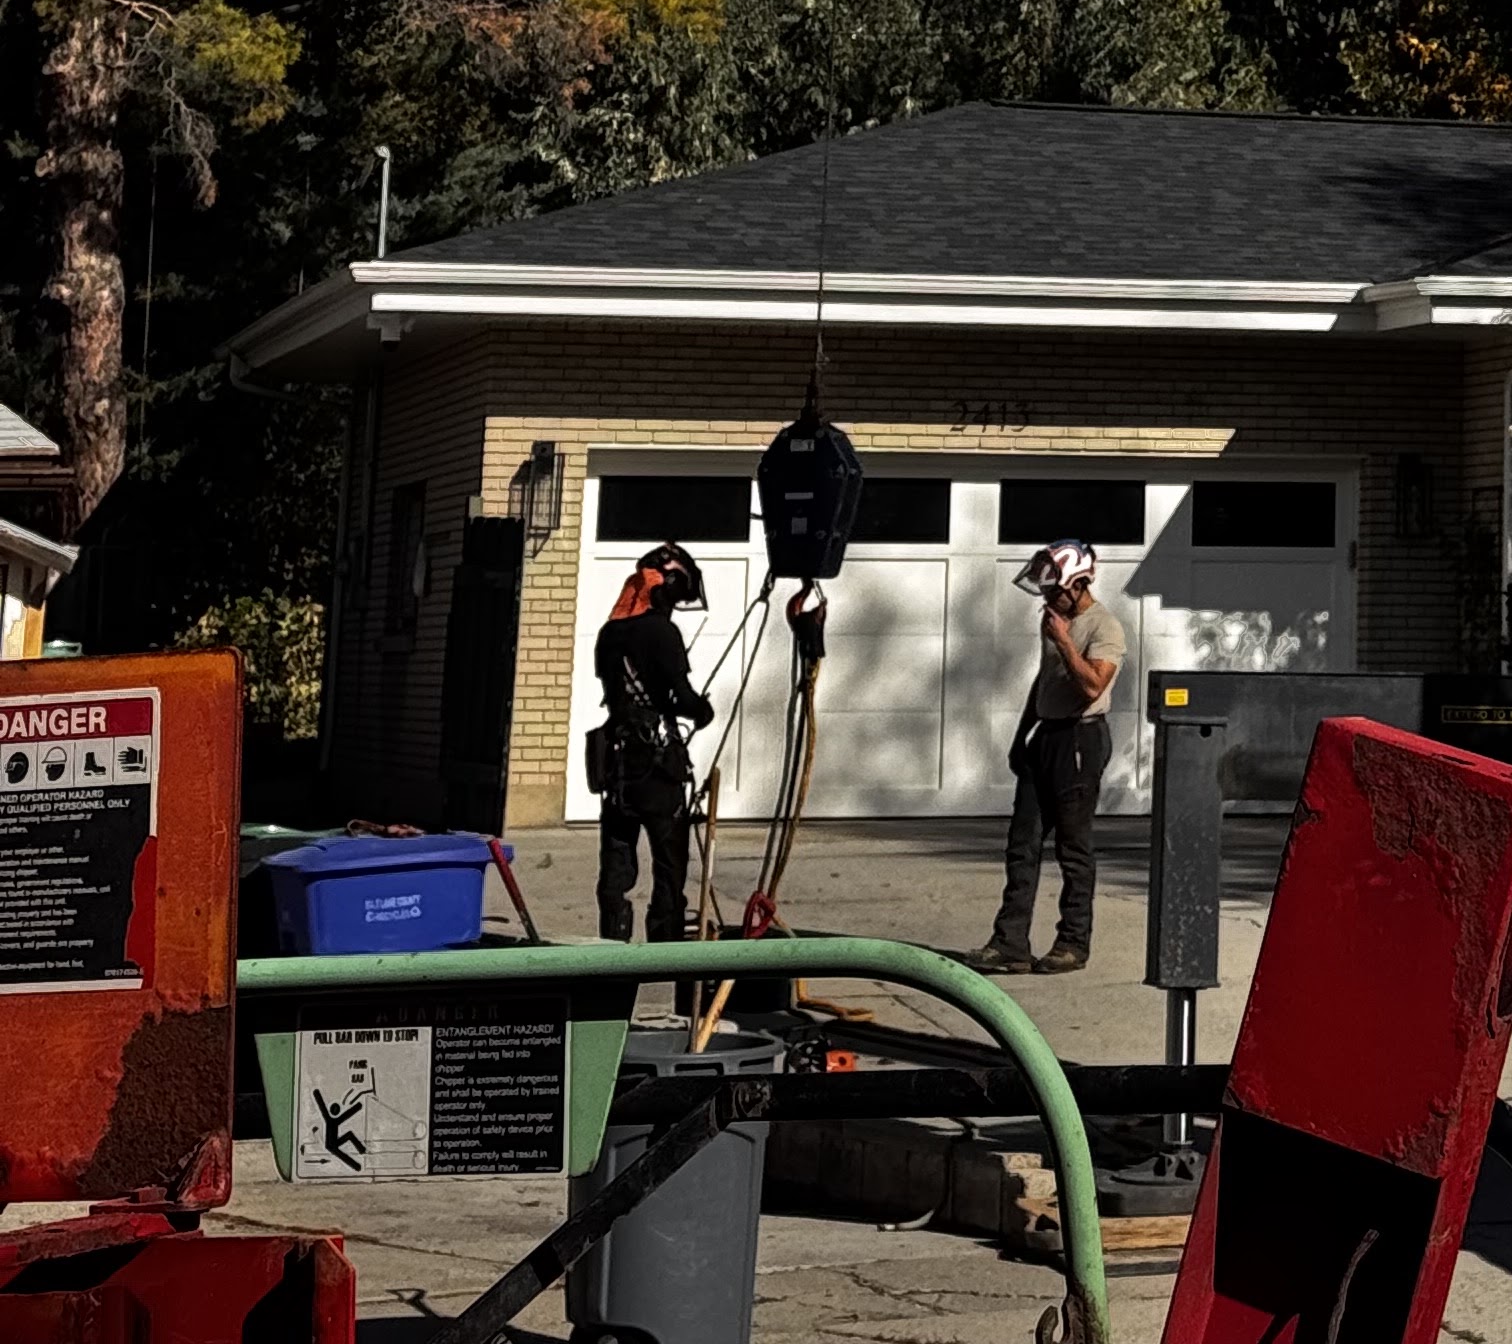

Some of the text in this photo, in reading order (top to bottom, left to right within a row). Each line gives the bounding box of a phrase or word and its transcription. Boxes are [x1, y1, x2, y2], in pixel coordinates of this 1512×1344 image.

[949, 400, 1029, 433] 2413
[20, 792, 67, 802] OPERATOR
[68, 789, 104, 800] HAZARD
[7, 802, 52, 813] QUALIFIED
[53, 800, 106, 812] PERSONNEL
[107, 799, 131, 809] ONLY
[313, 1032, 333, 1045] PULL
[355, 1030, 380, 1043] DOWN
